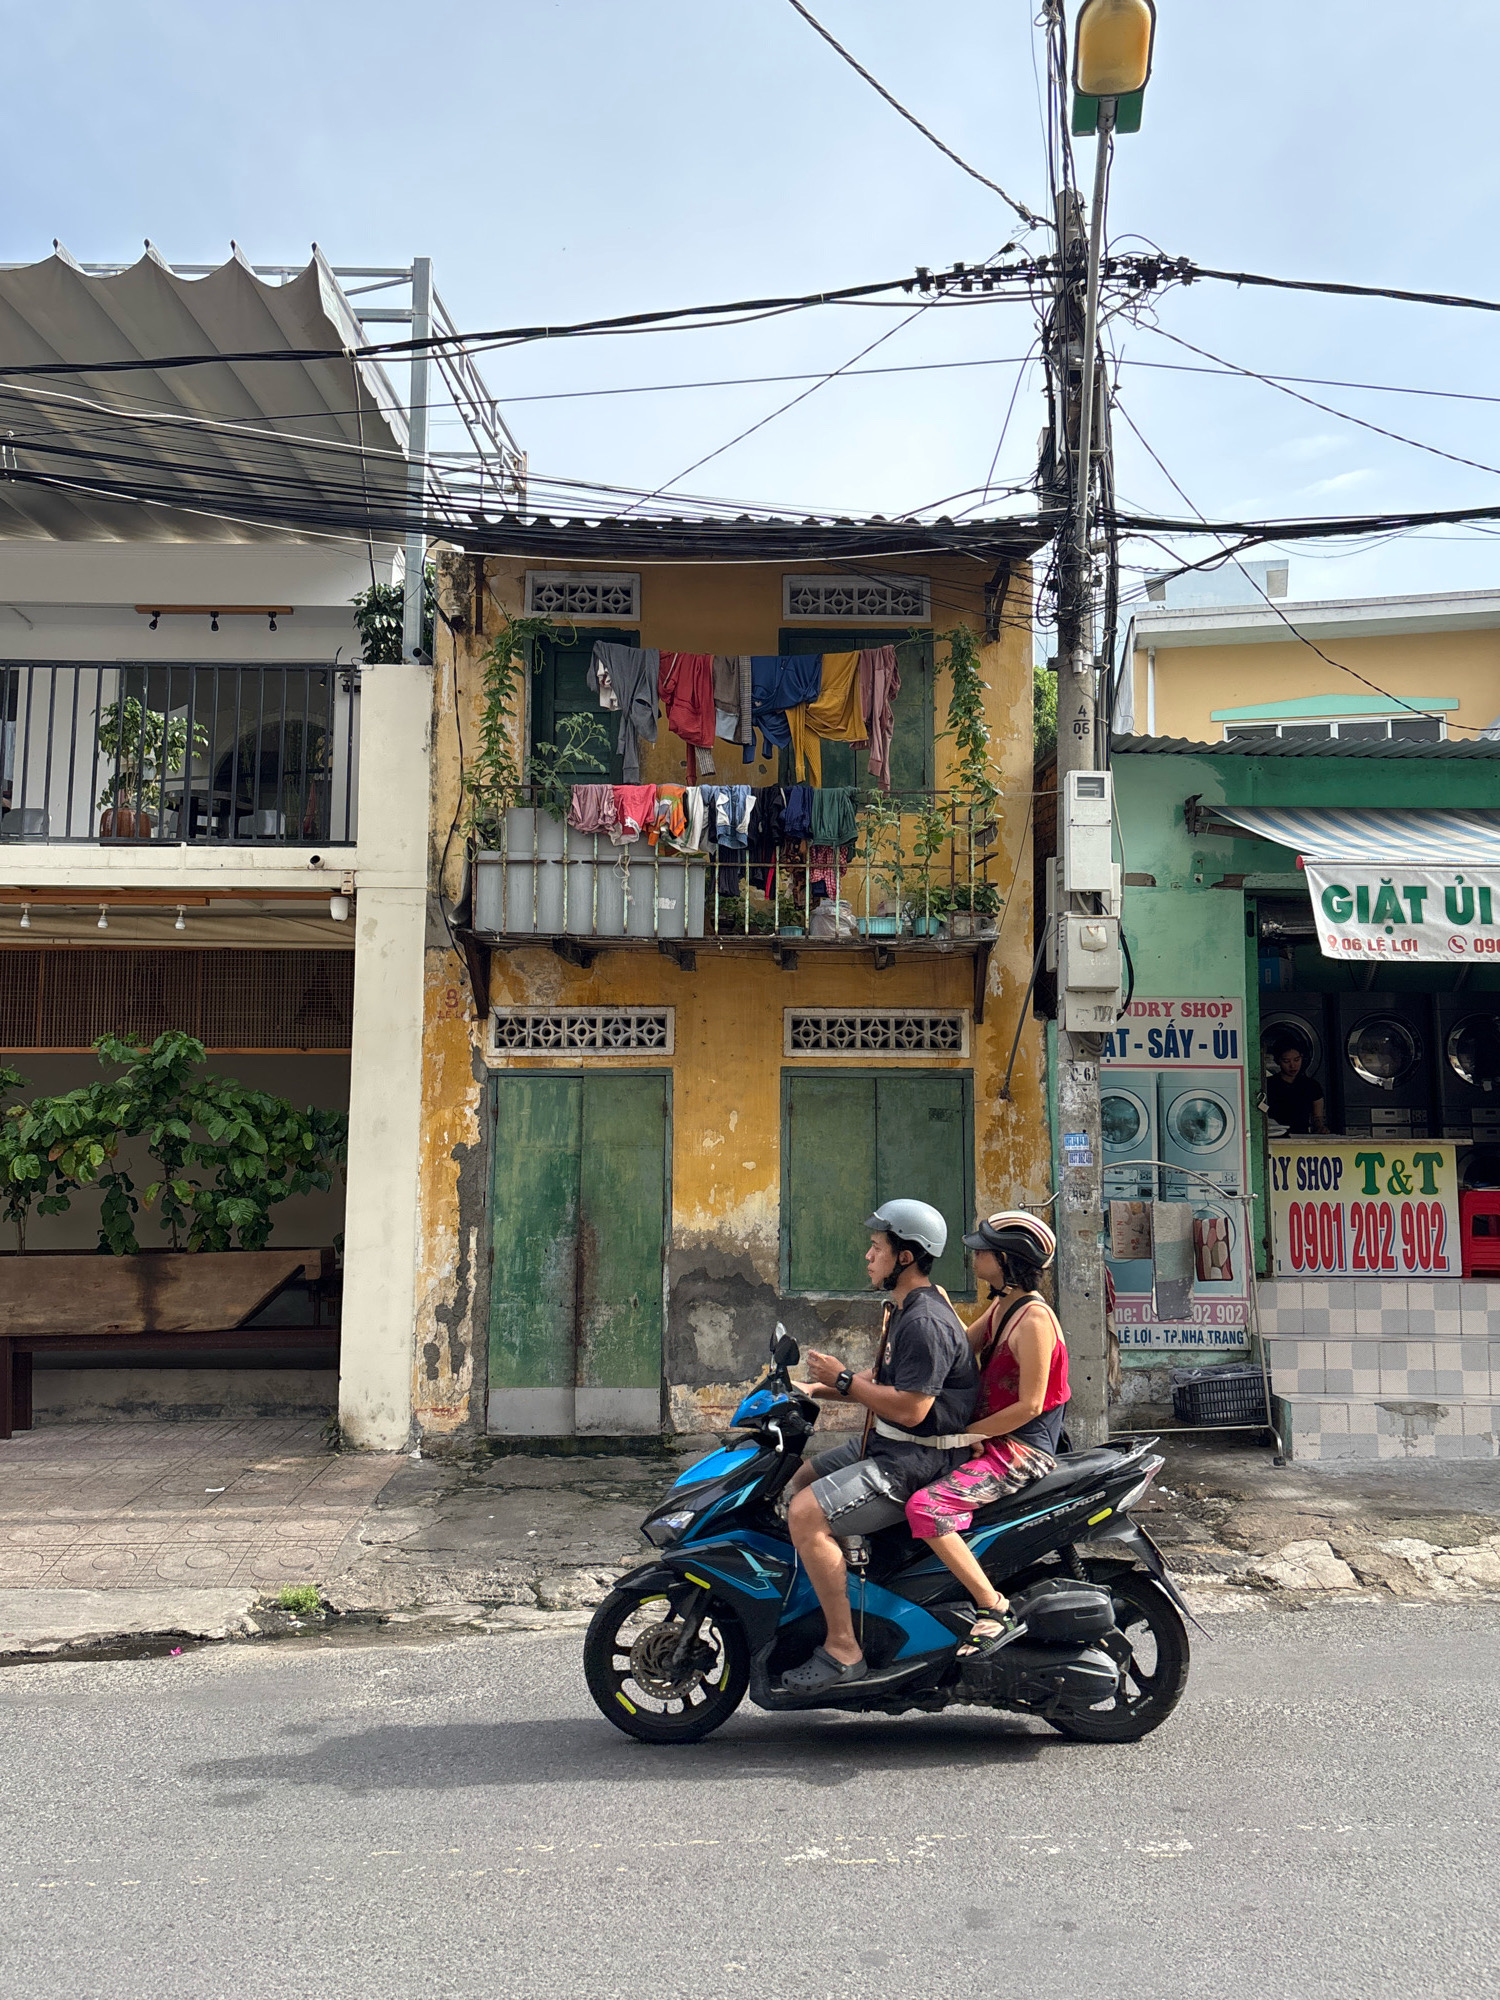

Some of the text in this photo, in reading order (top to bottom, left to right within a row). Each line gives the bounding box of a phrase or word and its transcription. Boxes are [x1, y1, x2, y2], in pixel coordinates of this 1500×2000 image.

[1077, 704, 1088, 718] 4
[1073, 722, 1090, 735] 06
[1321, 874, 1493, 935] GIẶT ỦI
[1341, 938, 1363, 951] 06
[1367, 937, 1387, 951] LÊ
[1391, 938, 1418, 955] LỢI
[1180, 1002, 1233, 1018] SHOP
[1148, 1019, 1194, 1059] SẤY
[1212, 1022, 1238, 1060] ỦI
[1296, 1156, 1343, 1191] SHOP
[1354, 1151, 1444, 1196] T&T
[1289, 1201, 1346, 1271] 0901
[1350, 1201, 1397, 1271] 202
[1400, 1201, 1449, 1271] 902
[1216, 1305, 1244, 1324] 902
[1118, 1326, 1131, 1344] LÊ
[1134, 1327, 1152, 1346] LỢI
[1207, 1330, 1245, 1345] TRANG
